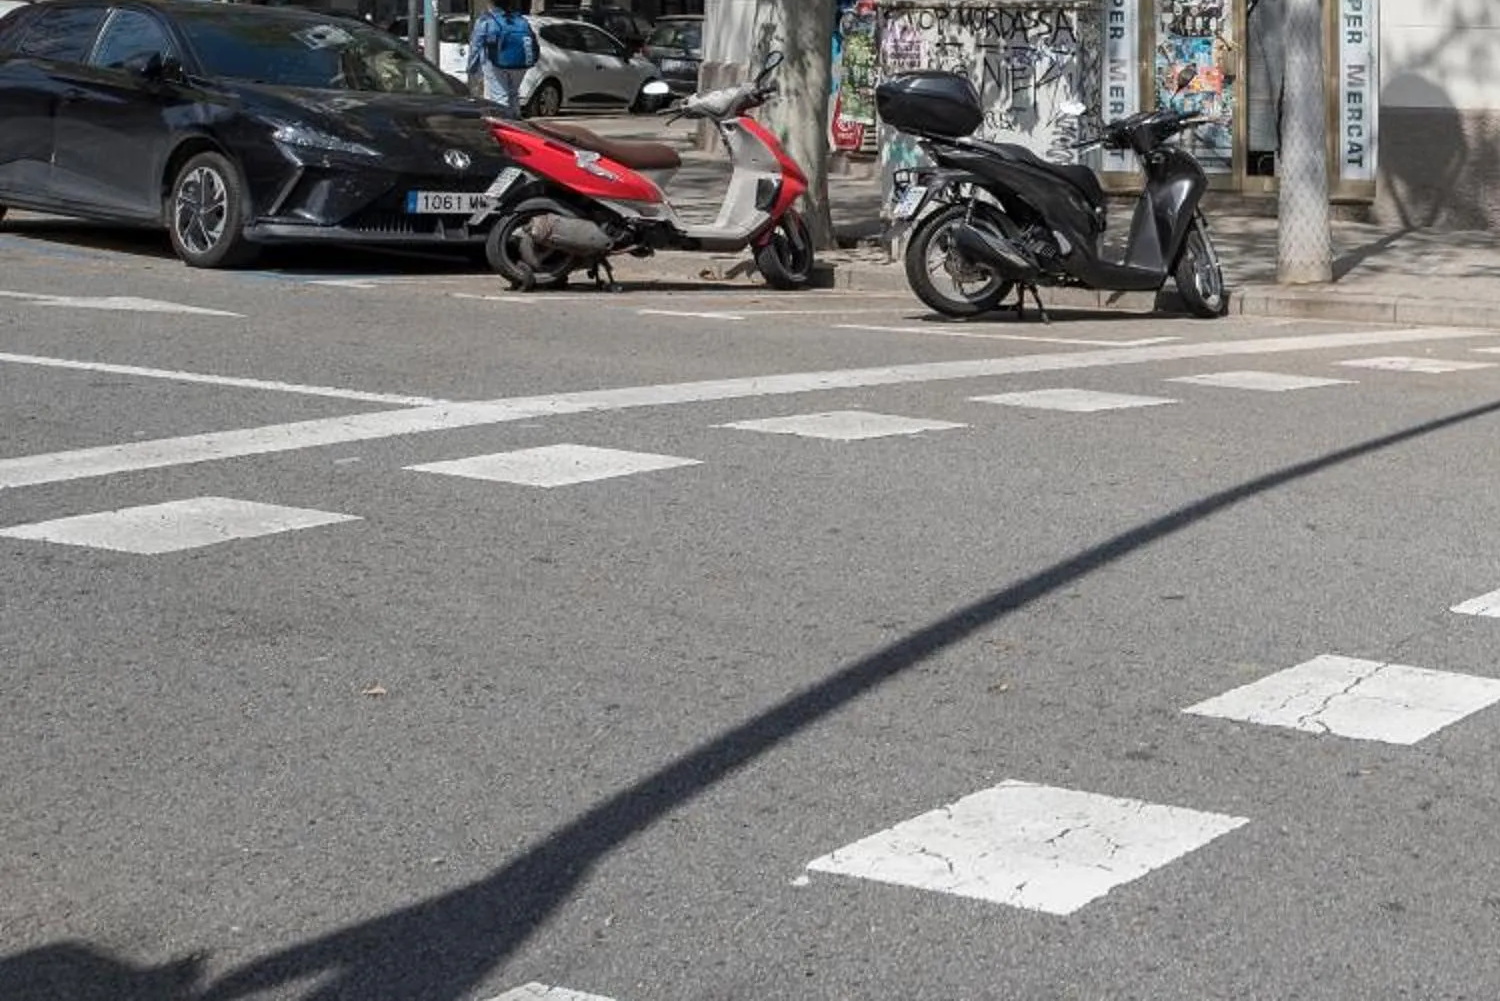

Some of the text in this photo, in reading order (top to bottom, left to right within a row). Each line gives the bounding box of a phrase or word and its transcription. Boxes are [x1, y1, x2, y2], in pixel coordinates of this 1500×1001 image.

[1109, 59, 1126, 161] MERT
[1347, 64, 1365, 168] MERCAT
[423, 195, 461, 210] 1061
